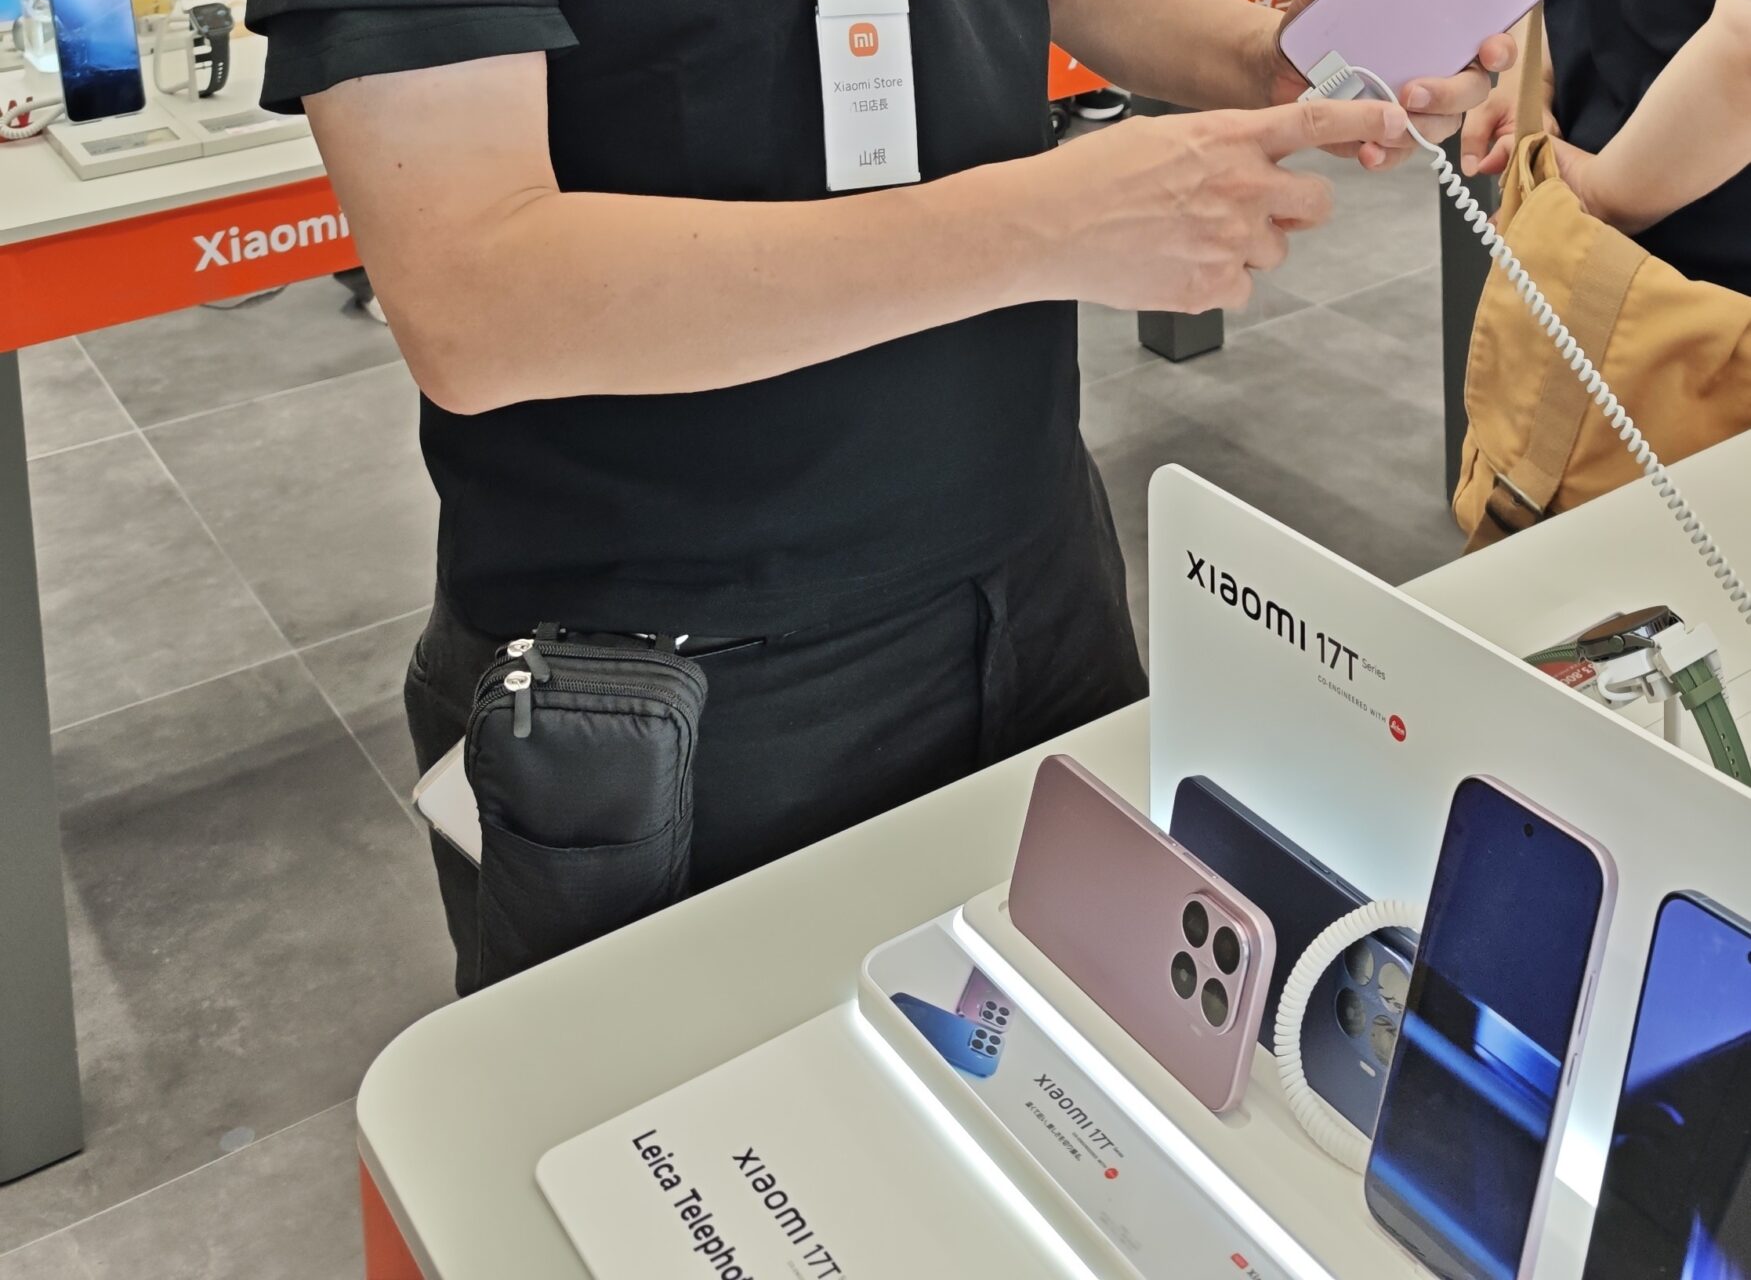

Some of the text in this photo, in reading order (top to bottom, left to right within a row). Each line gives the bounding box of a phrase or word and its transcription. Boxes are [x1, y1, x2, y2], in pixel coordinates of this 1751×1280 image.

[834, 77, 903, 93] Xiaomi Store
[851, 98, 889, 113] 1日店長
[859, 147, 887, 167] 山根
[193, 210, 350, 273] Xiaomi
[1316, 631, 1359, 682] 17T
[1361, 657, 1387, 681] Series
[1317, 674, 1368, 712] CO-ENGINEERED
[1369, 707, 1387, 724] WITH
[1088, 1128, 1115, 1150] 17T
[632, 1129, 754, 1280] Leica Telepho
[803, 1243, 842, 1280] 17T
